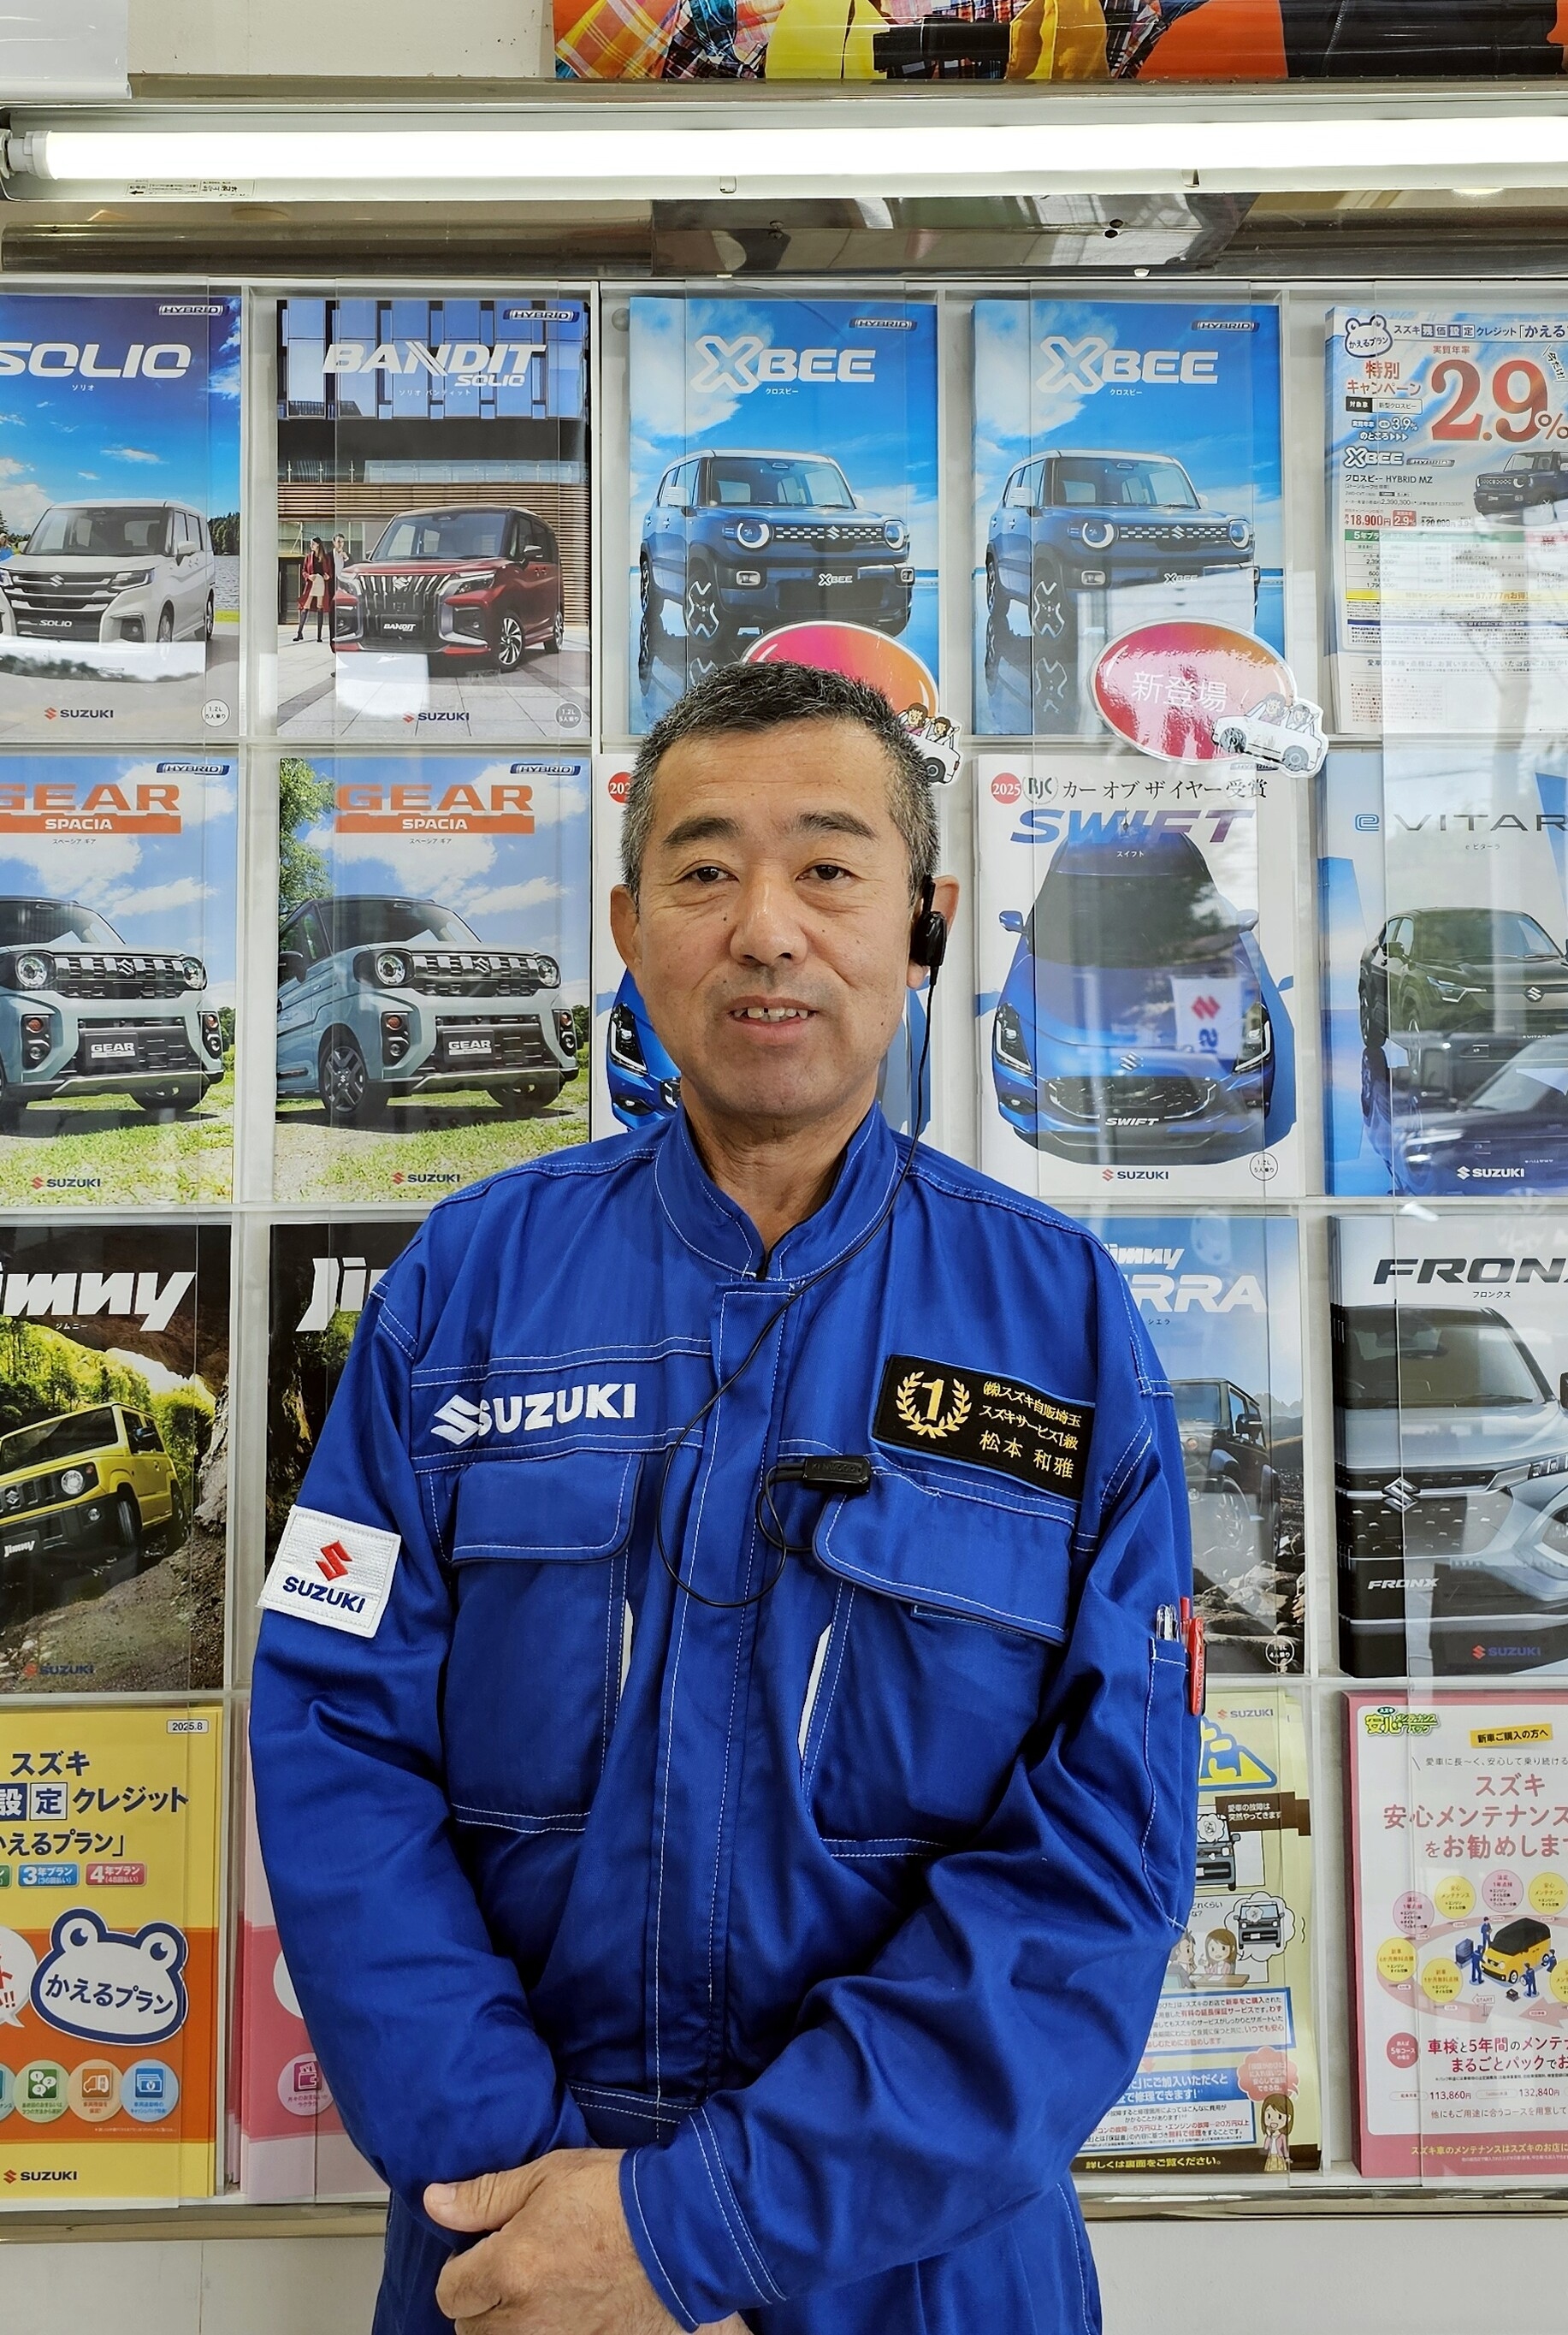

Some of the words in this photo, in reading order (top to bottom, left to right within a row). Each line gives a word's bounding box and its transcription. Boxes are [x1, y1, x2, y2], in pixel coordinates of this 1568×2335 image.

[163, 305, 219, 315] HYBRID
[514, 311, 569, 320] HYBRID
[859, 320, 909, 329] HYBRID
[1201, 322, 1252, 330] HYBRID
[1433, 345, 1470, 355] 実質年率
[322, 341, 547, 376] BANDIT
[690, 335, 876, 394] XBEE
[1036, 335, 1219, 394] XBEE
[1365, 360, 1400, 380] 特別
[455, 374, 525, 387] SOLIO
[1346, 379, 1422, 396] キャンペーン
[1344, 447, 1404, 468] XBEE
[1419, 476, 1433, 484] MZ
[1131, 670, 1228, 713] 新登場
[60, 709, 114, 719] SUZUKI
[417, 712, 470, 721] SUZUKI
[166, 764, 220, 773] HYBRID
[520, 765, 571, 773] HYBRID
[608, 781, 631, 795] 202
[991, 783, 1021, 796] 2025
[335, 784, 534, 811] GEAR
[44, 818, 113, 830] SPACIA
[402, 818, 468, 830] SPACIA
[1009, 809, 1255, 844] SWIFT
[91, 1042, 134, 1052] GEAR
[448, 1040, 491, 1050] GEAR
[1105, 1117, 1159, 1126] SWIFT
[407, 1174, 460, 1183] SUZUKI
[1117, 1170, 1169, 1180] SUZUKI
[1472, 1168, 1525, 1178] SUZUKI
[46, 1178, 101, 1188] SUZUKI
[1373, 1258, 1568, 1284] FRON
[0, 1261, 197, 1331] mny
[296, 1257, 390, 1332] Ji
[1472, 1290, 1512, 1299] フロンクス
[56, 1321, 88, 1330] ジムニー
[920, 1378, 944, 1422] 1
[479, 1383, 637, 1436] SUZUKI
[979, 1430, 1024, 1458] 松本
[3, 1540, 36, 1558] Jimny
[1368, 1578, 1440, 1590] FRONX
[282, 1575, 366, 1614] SUZUKI
[1488, 1647, 1541, 1656] SUZUKI
[39, 1664, 94, 1675] SUZUKI
[1230, 1709, 1274, 1718] SUZUKI
[172, 1722, 203, 1731] 2025.8
[1477, 1729, 1548, 1744] 新車ご購入の方へ
[10, 1750, 91, 1777] スズキ
[1476, 1772, 1545, 1797] スズキ
[1383, 1805, 1568, 1829] 安心メンテナンス
[0, 1828, 125, 1857] えるプラン」
[45, 1973, 174, 2015] かえるプラン
[1429, 2090, 1472, 2101] 113,860円
[1518, 2087, 1560, 2097] 132,840円
[1086, 2157, 1222, 2170] 詳しくは裏面をご覧ください。
[21, 2171, 78, 2181] SUZUKI
